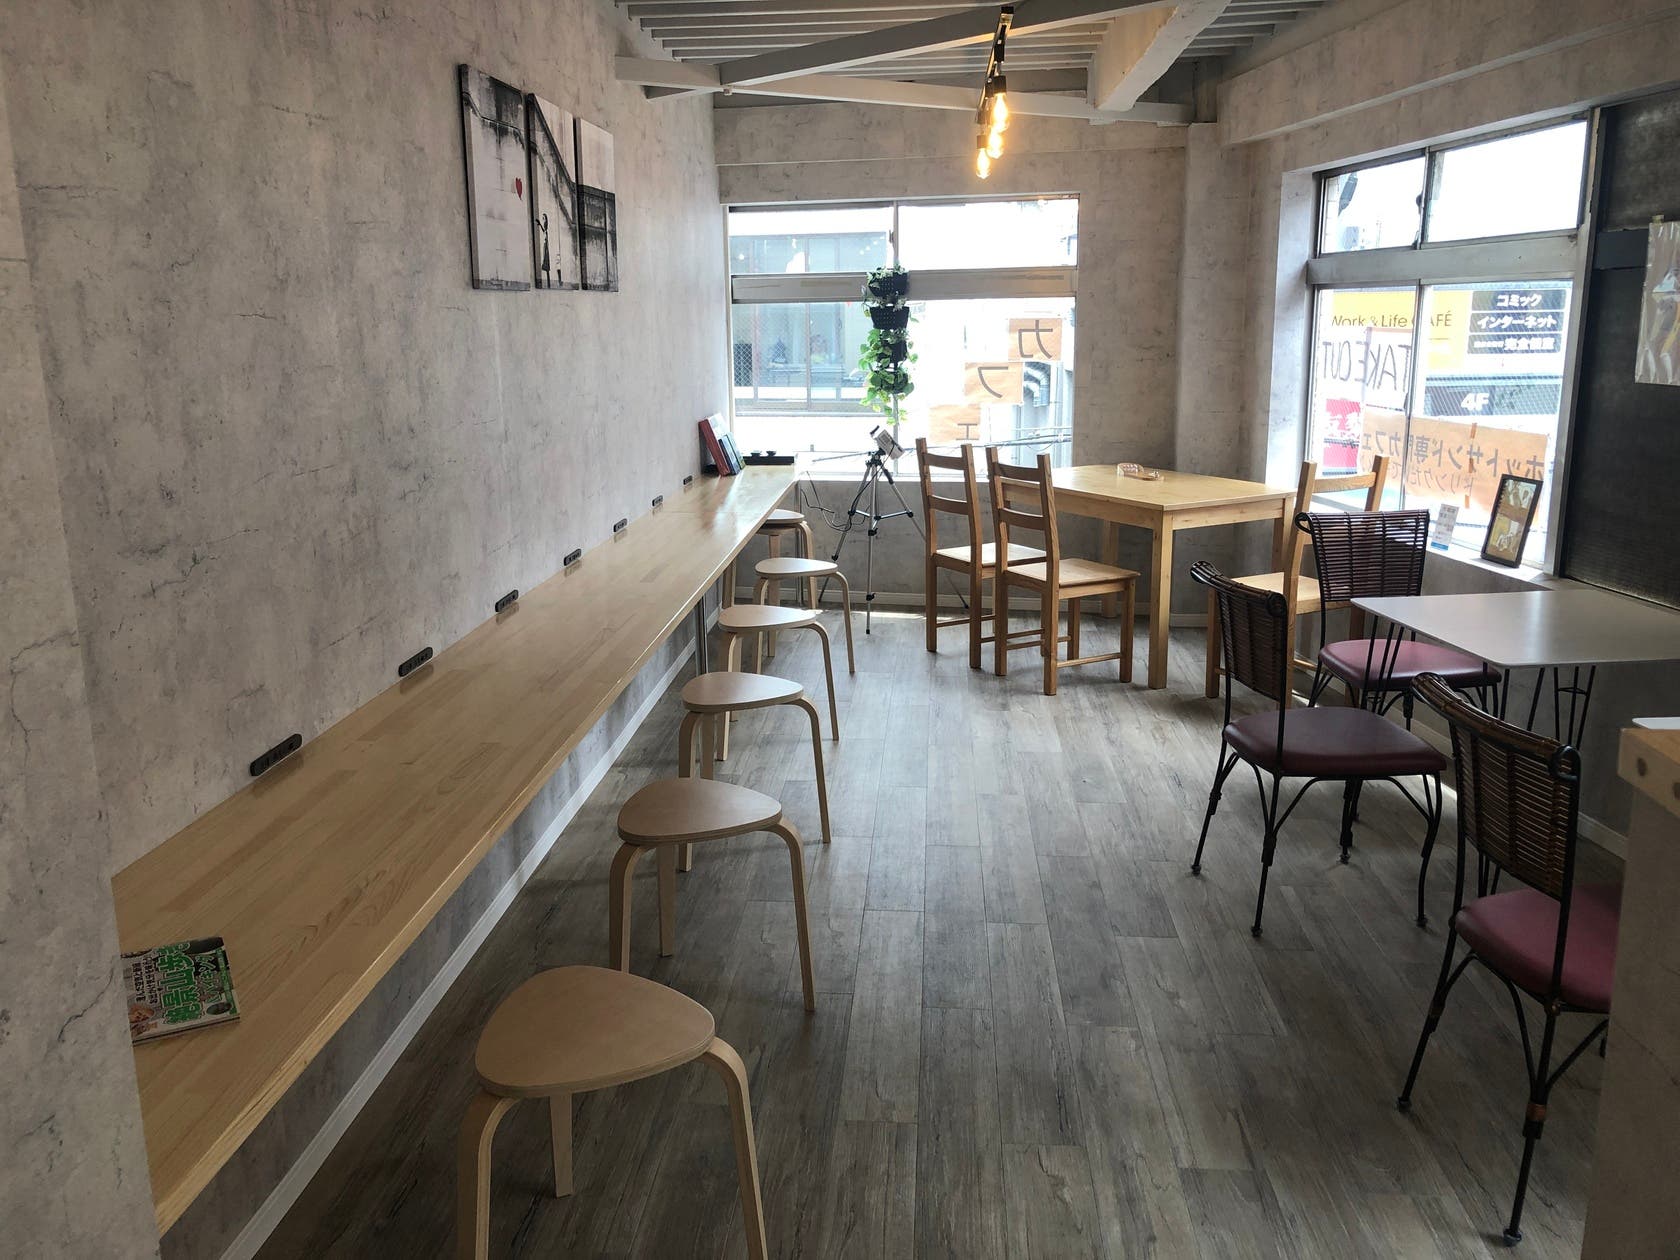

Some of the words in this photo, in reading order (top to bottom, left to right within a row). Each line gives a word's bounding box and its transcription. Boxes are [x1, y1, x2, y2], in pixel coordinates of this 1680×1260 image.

[1496, 294, 1542, 307] コミック
[1381, 313, 1408, 328] Life
[1477, 315, 1557, 329] インターネット
[1461, 392, 1490, 412] 4F
